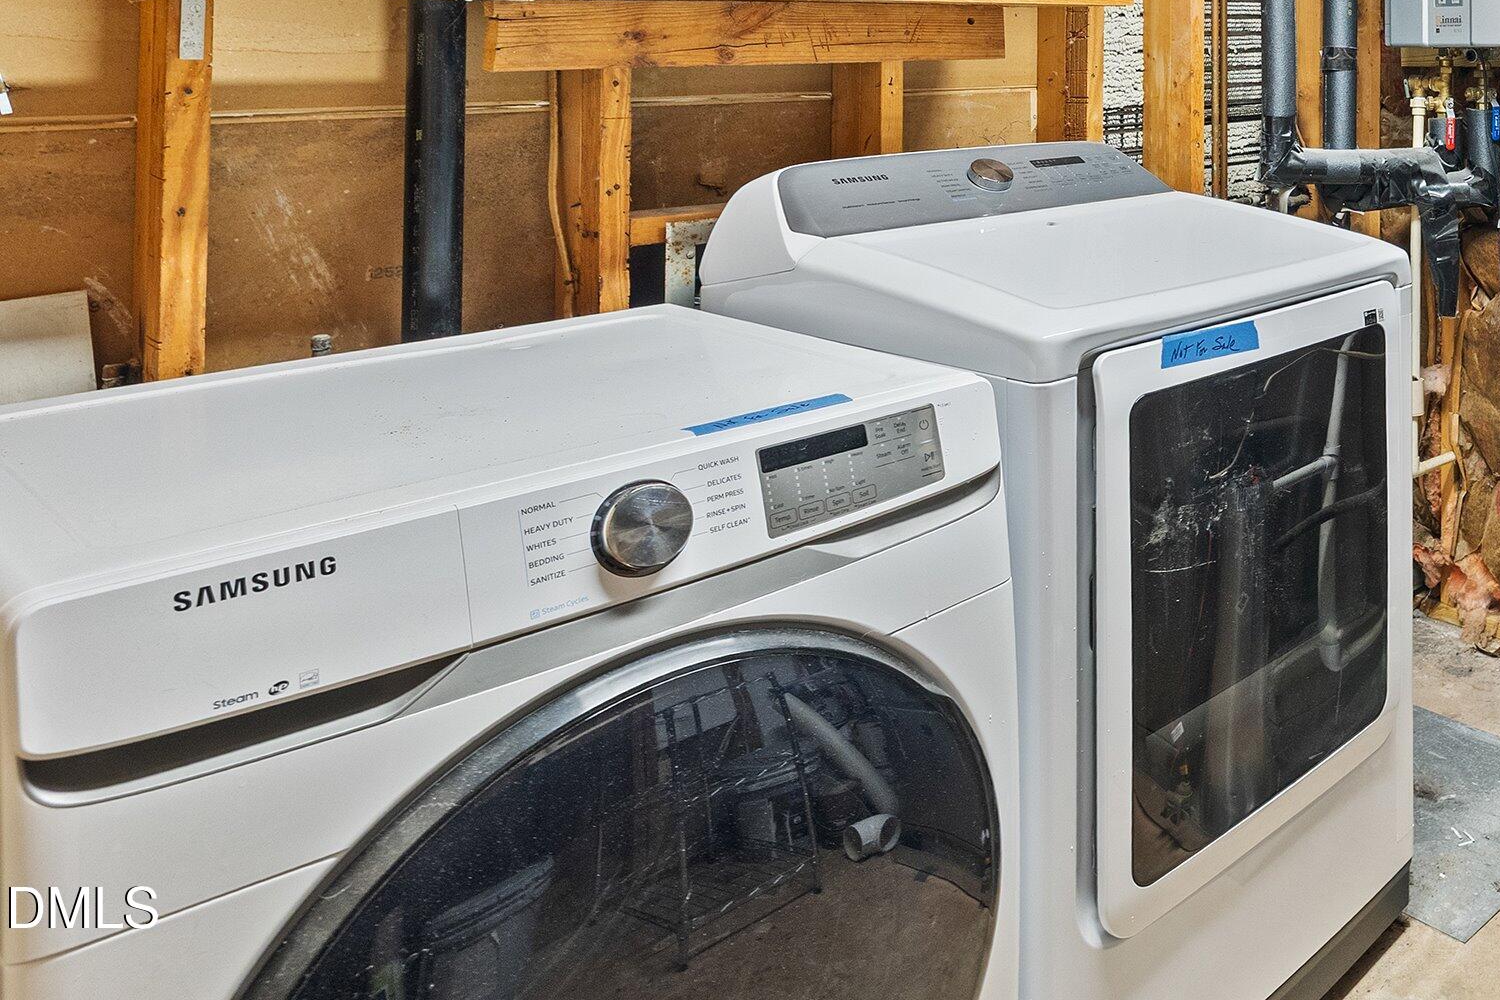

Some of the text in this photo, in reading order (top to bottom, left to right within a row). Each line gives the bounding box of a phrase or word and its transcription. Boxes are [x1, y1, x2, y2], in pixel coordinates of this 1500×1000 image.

[1435, 14, 1463, 25] Rinnai
[831, 172, 889, 187] SAMSUNG
[1171, 342, 1194, 363] Not
[1212, 336, 1241, 352] Sale
[697, 455, 740, 471] QUICK WASH
[706, 472, 743, 488] DELICATES
[706, 488, 745, 503] PERM PRESS
[520, 500, 557, 516] NORMAL
[523, 516, 575, 536] HEAVY DUTY
[709, 524, 725, 534] SELF
[525, 537, 558, 553] WHITES
[528, 552, 566, 570] BEDDING
[173, 556, 338, 613] SAMSUNG
[530, 569, 567, 588] SANITIZE
[541, 602, 567, 617] Steam
[212, 690, 260, 711] Steam
